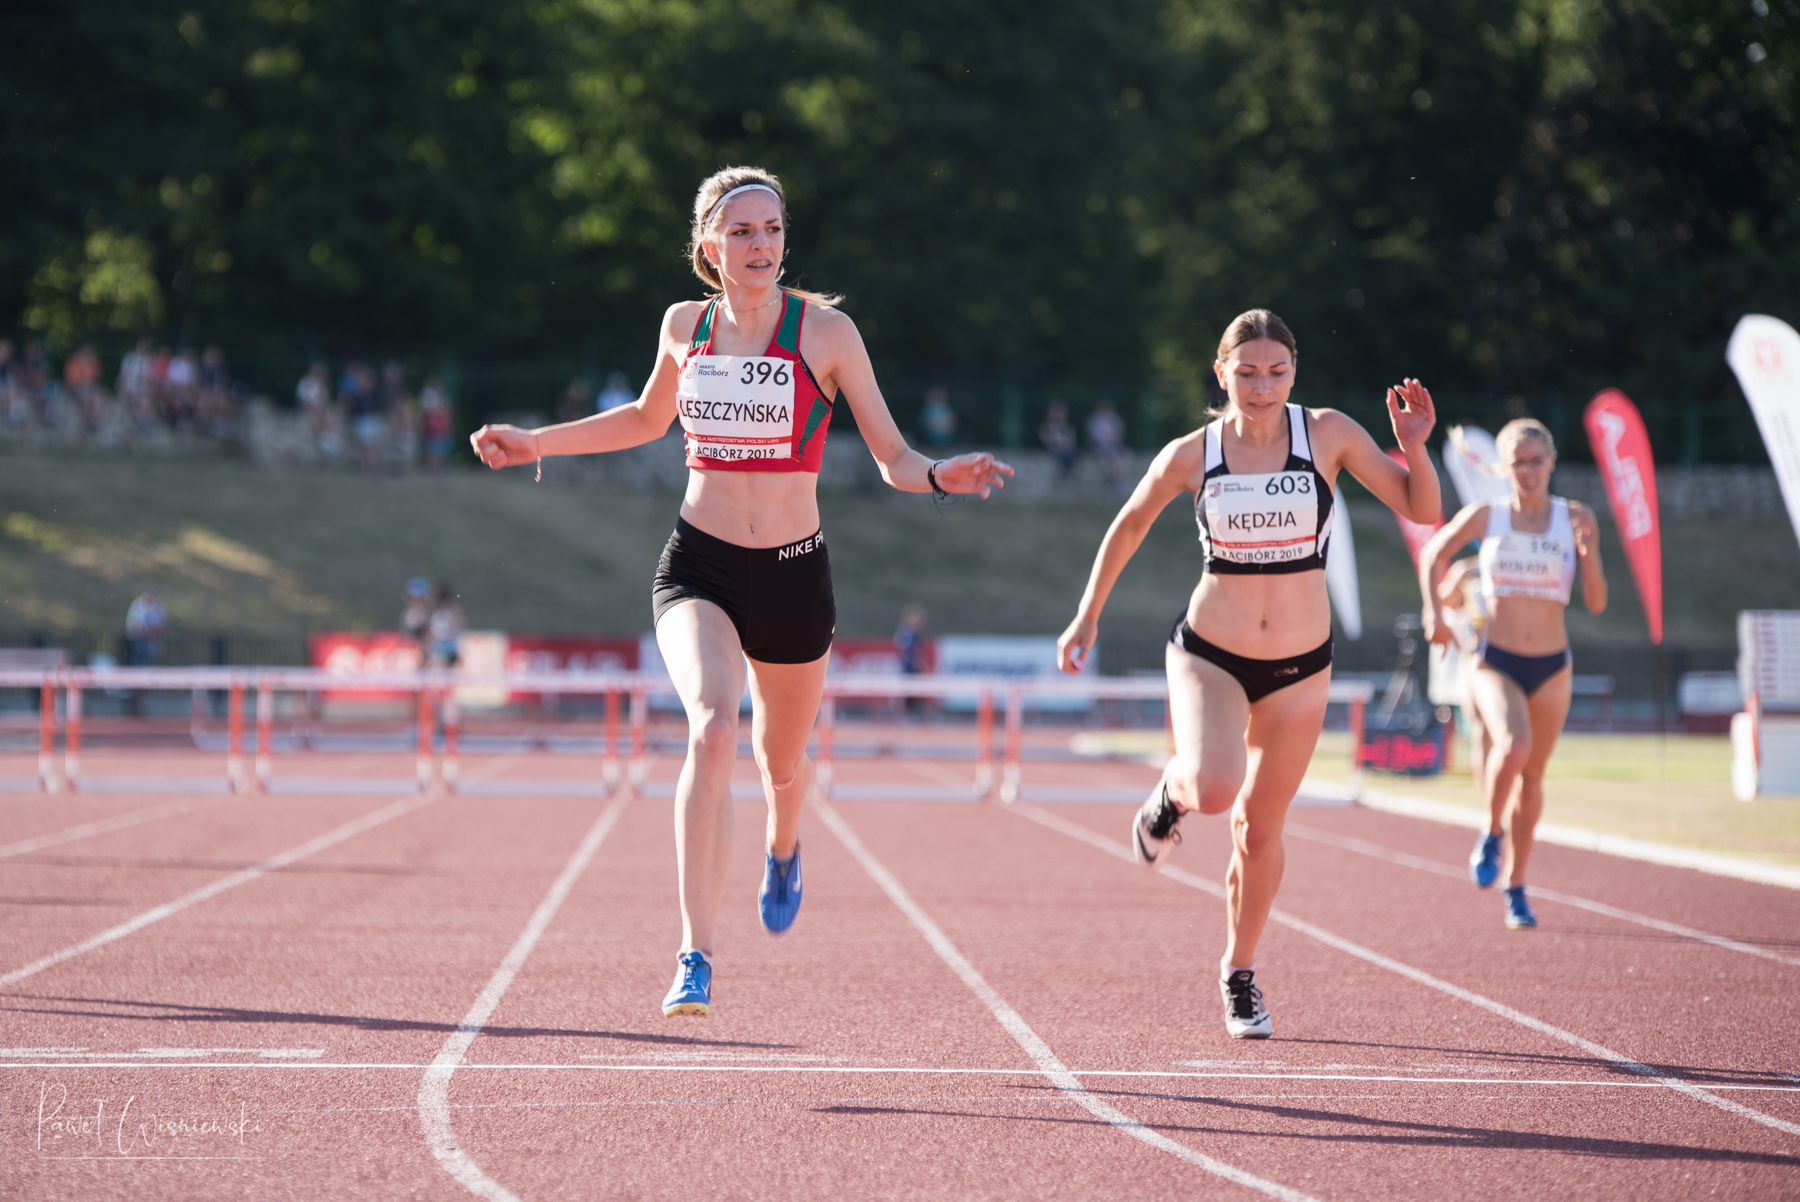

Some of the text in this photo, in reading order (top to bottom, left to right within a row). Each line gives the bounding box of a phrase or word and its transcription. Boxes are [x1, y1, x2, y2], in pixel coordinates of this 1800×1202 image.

[698, 368, 729, 377] Racibórz
[740, 361, 789, 386] 396
[679, 399, 790, 424] LESZCZYŃSKA
[747, 448, 776, 460] 2019
[1265, 475, 1311, 496] 603
[1228, 511, 1297, 533] KĘDZIA
[778, 539, 814, 561] NIKE
[1222, 547, 1303, 561] RACIBÓRZ 2019
